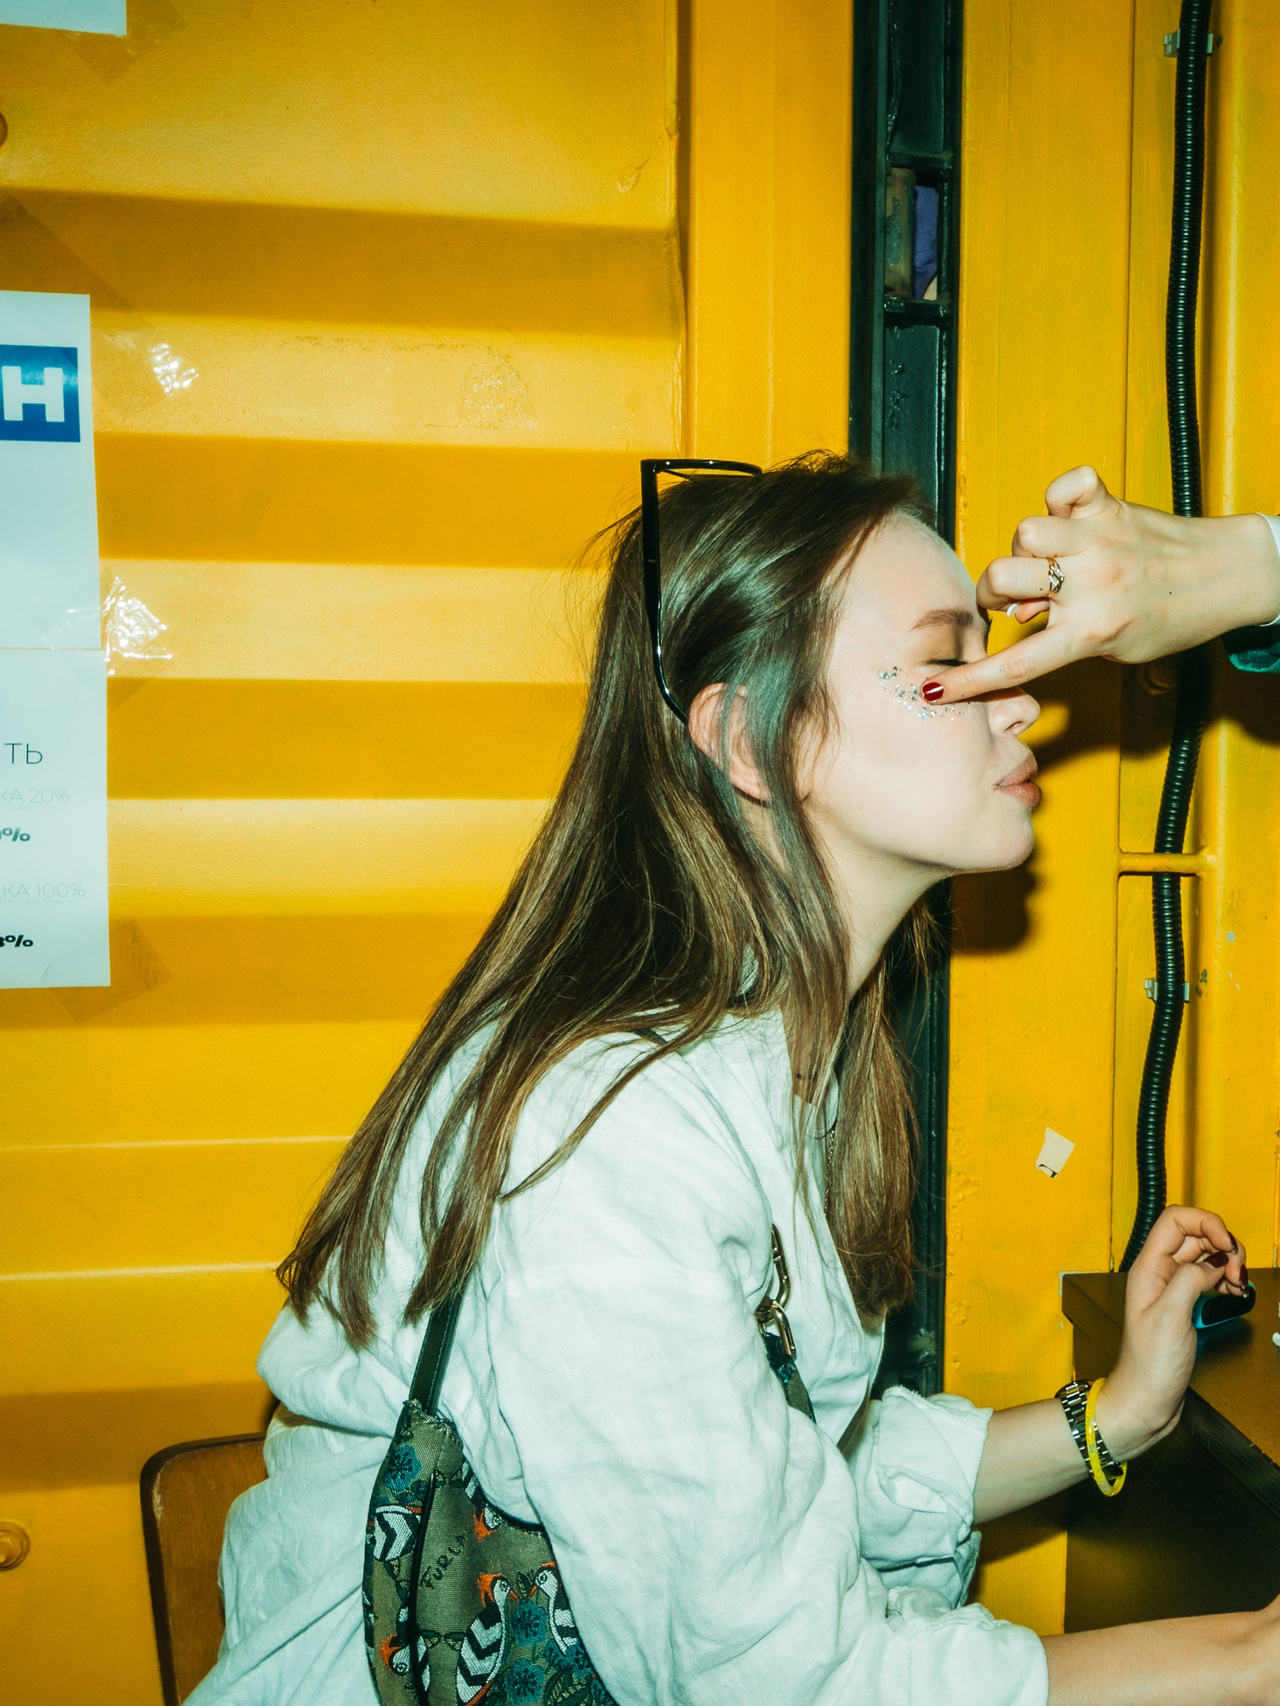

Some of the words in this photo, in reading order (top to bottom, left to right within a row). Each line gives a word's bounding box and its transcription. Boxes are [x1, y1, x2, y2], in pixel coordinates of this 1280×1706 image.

[28, 788, 71, 804] 20%
[0, 882, 31, 899] КА
[35, 882, 86, 898] 100%
